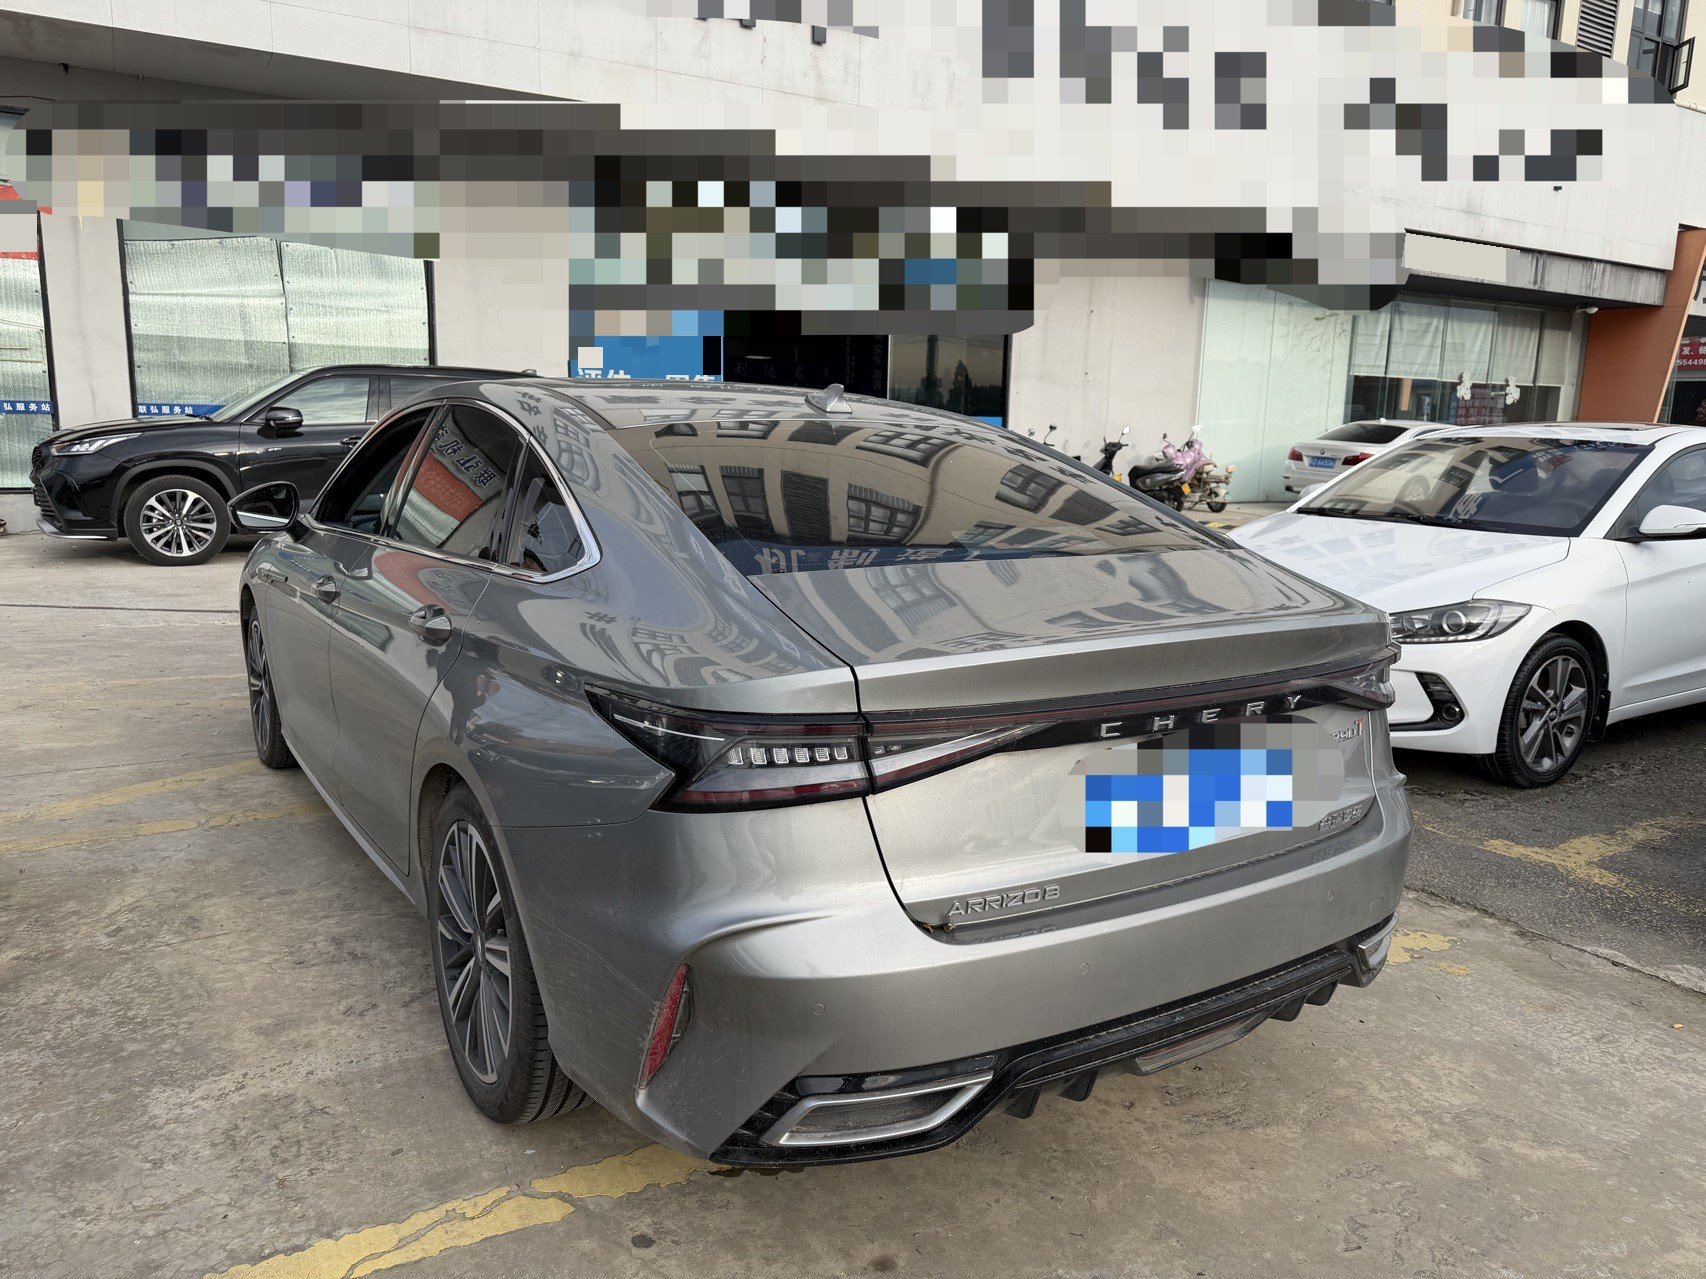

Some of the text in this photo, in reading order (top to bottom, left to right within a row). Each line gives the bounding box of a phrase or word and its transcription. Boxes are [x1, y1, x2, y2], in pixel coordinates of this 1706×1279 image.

[3, 402, 51, 412] 弘服务站
[138, 404, 194, 414] 联弘服务站
[1101, 694, 1302, 738] CHERY
